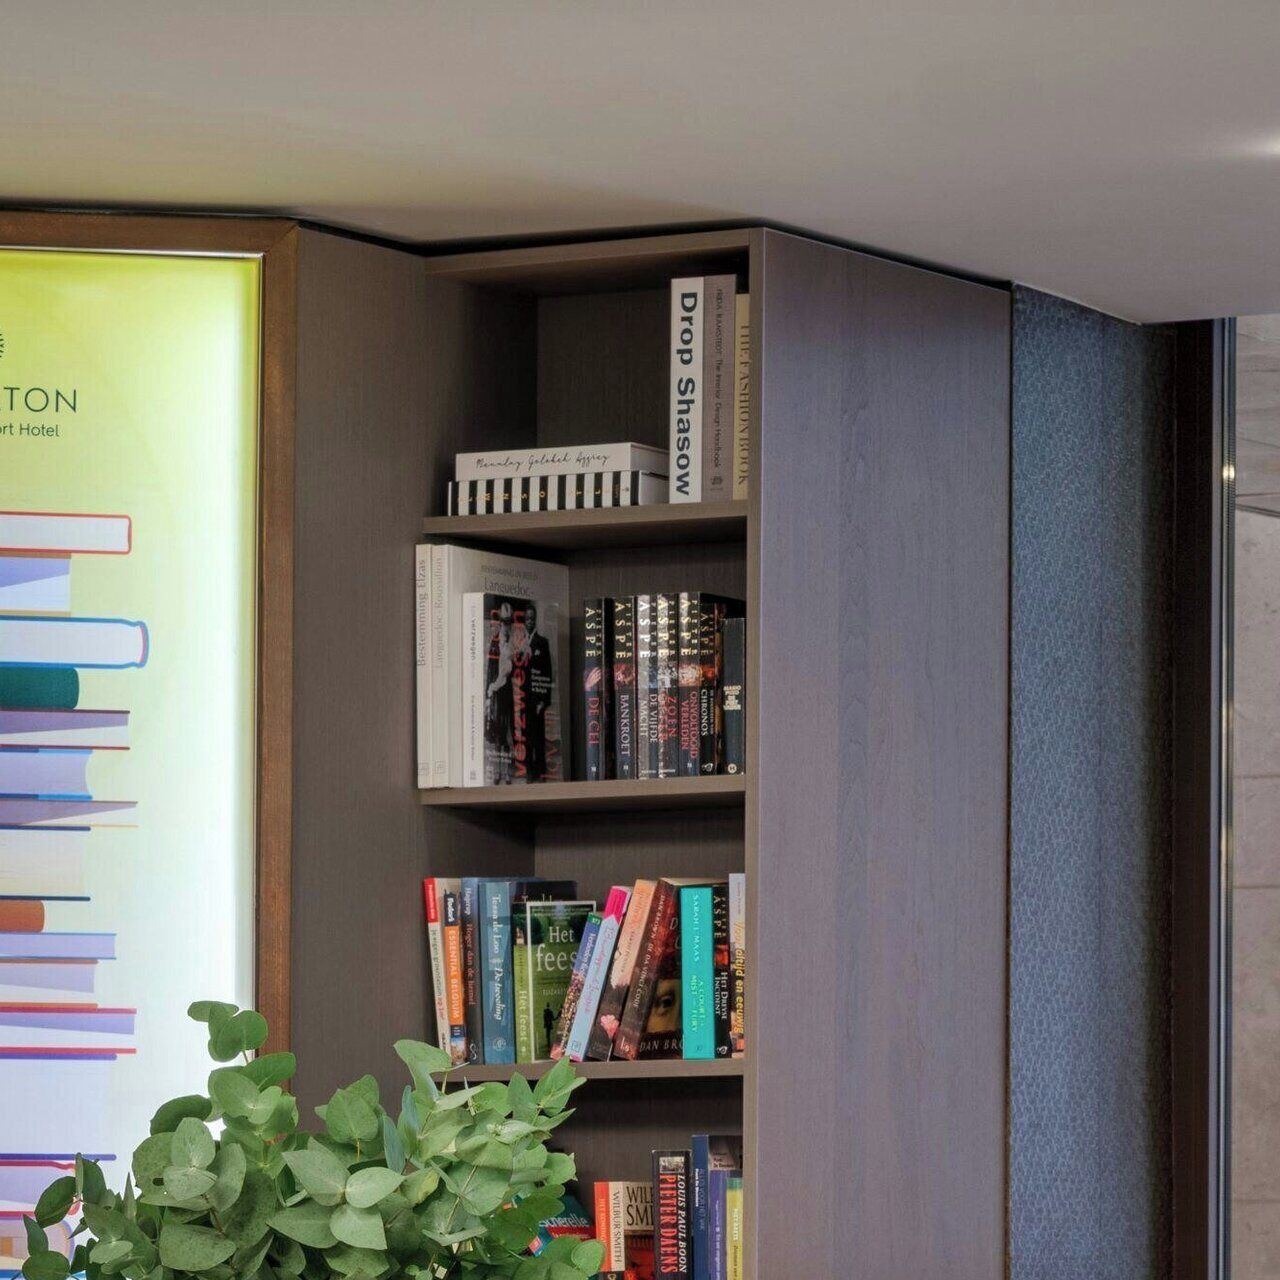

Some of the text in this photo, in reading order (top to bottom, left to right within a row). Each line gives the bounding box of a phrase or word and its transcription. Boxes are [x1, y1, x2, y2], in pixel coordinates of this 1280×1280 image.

[675, 291, 698, 497] Drop Shasow
[19, 422, 60, 437] Hotel
[417, 558, 428, 667] Bestemming Elzas
[585, 606, 596, 658] ASPE
[614, 601, 626, 659] ASPE
[624, 602, 632, 658] PIETER
[638, 600, 651, 659] ASPE
[657, 598, 670, 658] ASPE
[680, 598, 693, 657] ASPE
[691, 599, 699, 657] PIETER
[700, 612, 710, 657] ASPE
[619, 693, 631, 758] BANKROET
[639, 700, 648, 738] MACHT
[649, 693, 658, 744] DE VIJFDE
[667, 694, 678, 738] ZOEN
[680, 700, 690, 751] VERLEDEN
[689, 690, 699, 760] ONVOLTOOID
[700, 688, 709, 738] CHRONOS
[492, 895, 502, 954] Tessa de Loo
[548, 926, 575, 944] Het
[713, 895, 722, 939] ASPE
[448, 929, 460, 1020] ESSENTIAL BELGIUM
[493, 965, 507, 1022] De tweeling
[690, 975, 699, 996] MIST
[519, 990, 529, 1042] Het feest
[612, 1190, 624, 1265] WILBUR SMITH
[659, 1174, 679, 1274] PIETER DAENS
[677, 1174, 688, 1273] LOUIS PAUL BOON
